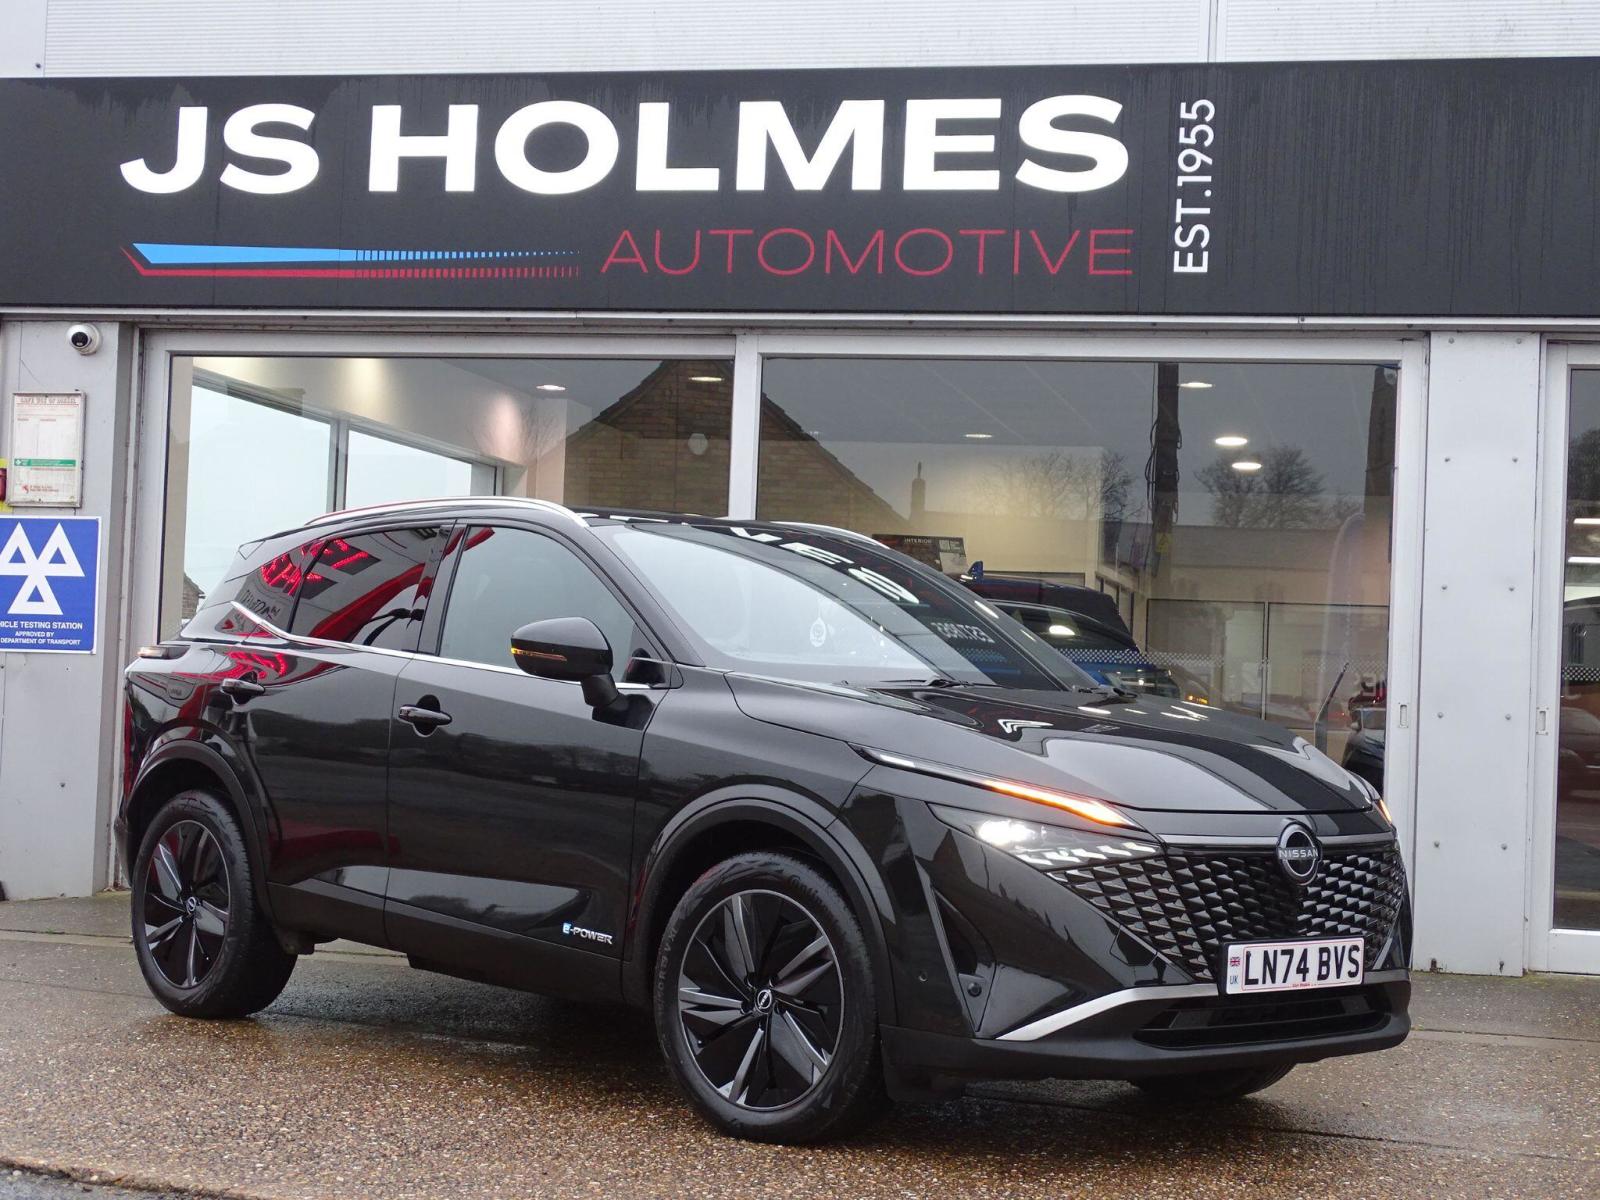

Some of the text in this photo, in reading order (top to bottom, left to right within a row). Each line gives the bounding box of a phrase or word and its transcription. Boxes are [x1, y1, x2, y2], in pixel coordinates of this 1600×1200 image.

[120, 94, 1129, 195] JS HOLMES
[1173, 99, 1216, 273] EST.1955
[600, 227, 1134, 277] AUTOMOTIVE
[20, 621, 51, 630] TESTING
[52, 621, 83, 630] STATION
[1279, 848, 1319, 859] NISSAN
[1229, 975, 1239, 985] UK
[1244, 944, 1360, 986] LN74 BVS
